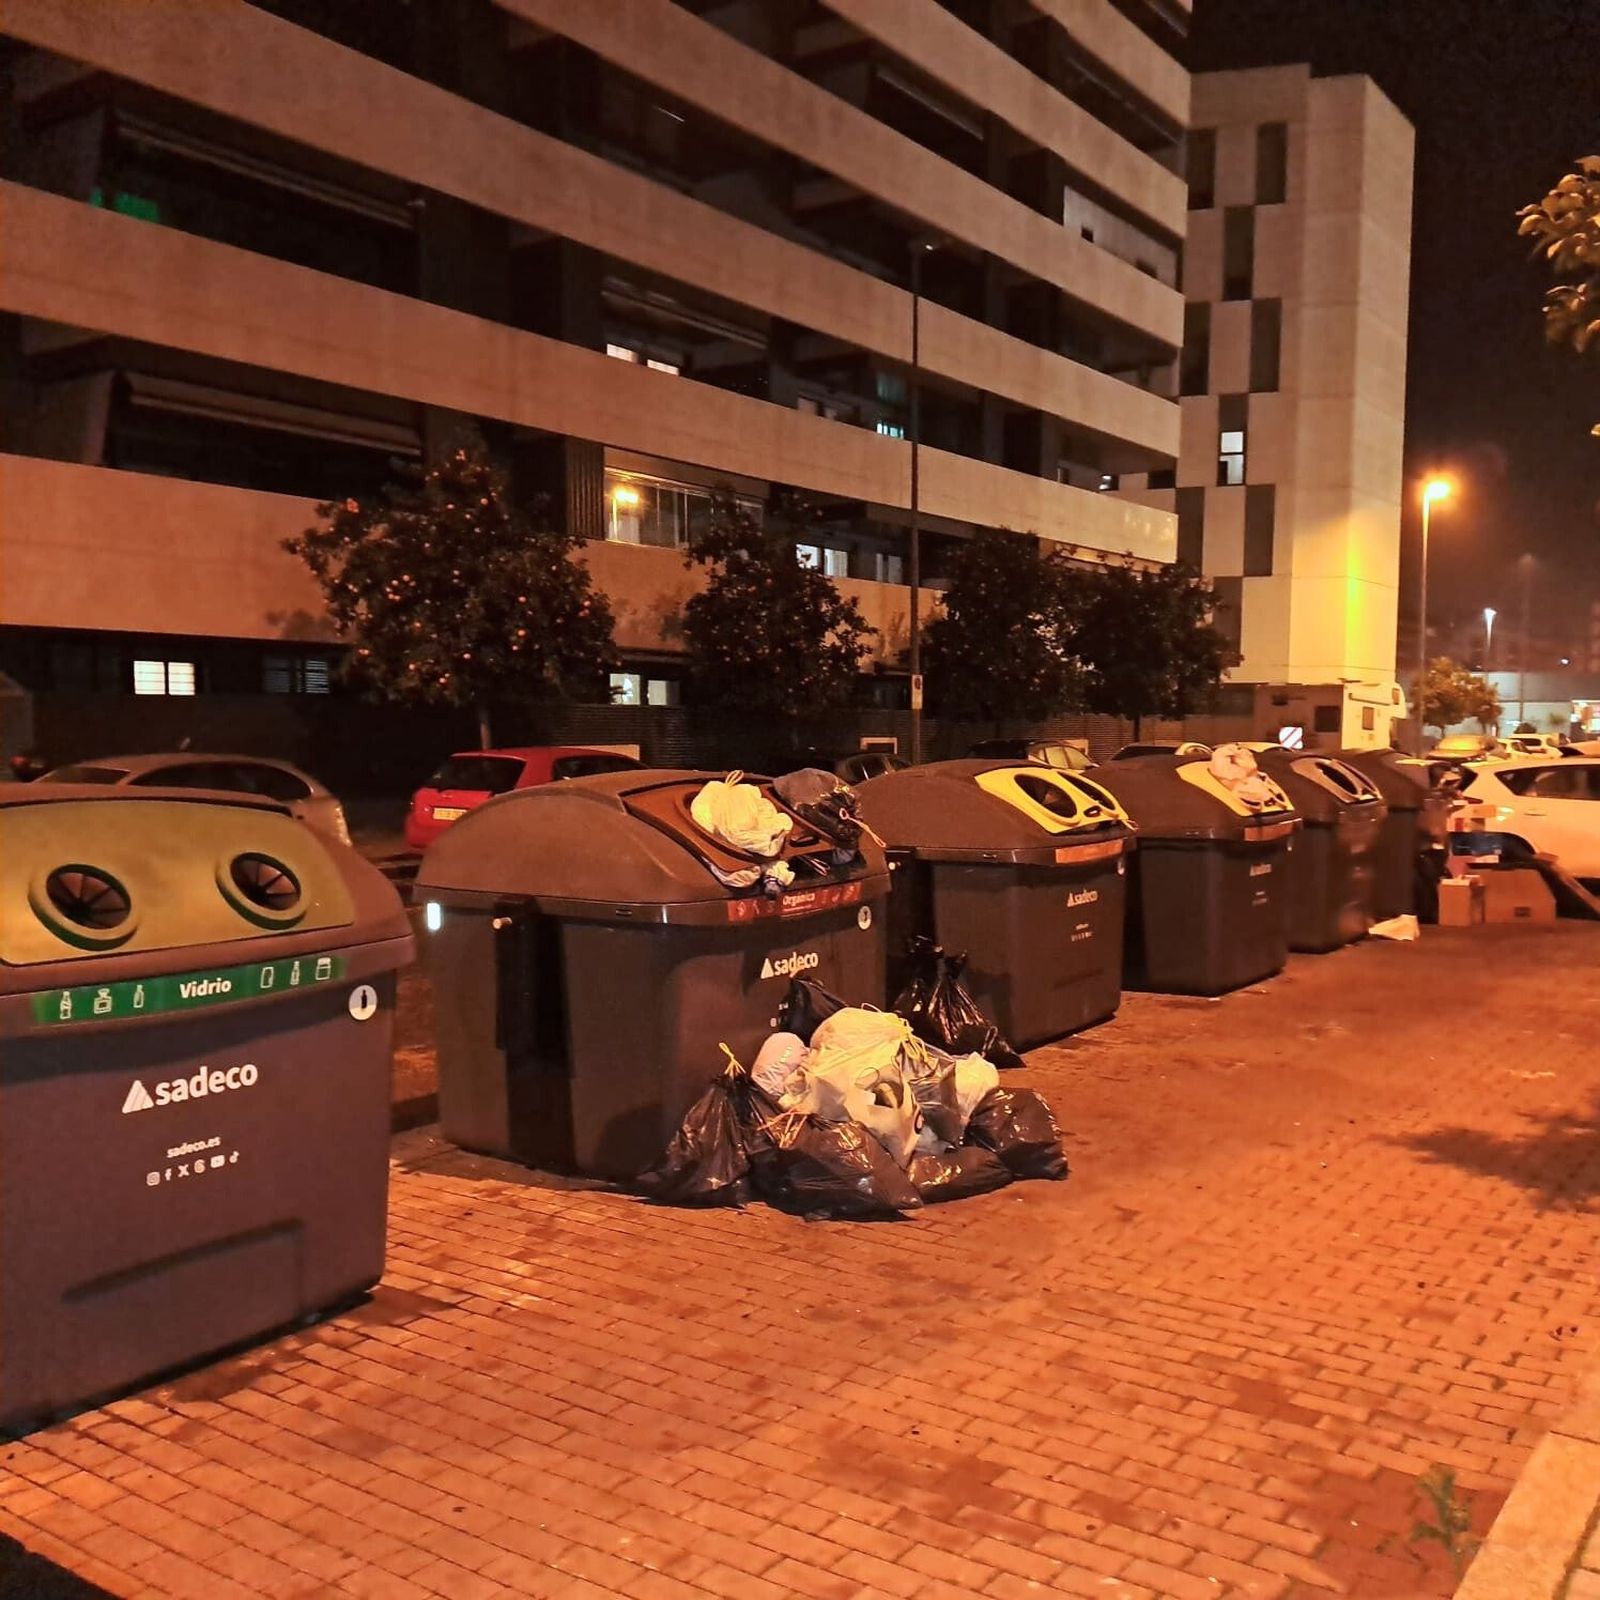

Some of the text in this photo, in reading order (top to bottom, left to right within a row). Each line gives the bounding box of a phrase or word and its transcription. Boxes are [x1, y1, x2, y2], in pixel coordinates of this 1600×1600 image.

[774, 951, 819, 976] sadeco
[179, 978, 231, 998] Vidrio
[155, 1063, 258, 1106] sadeco
[166, 1136, 221, 1159] sadeco.es
